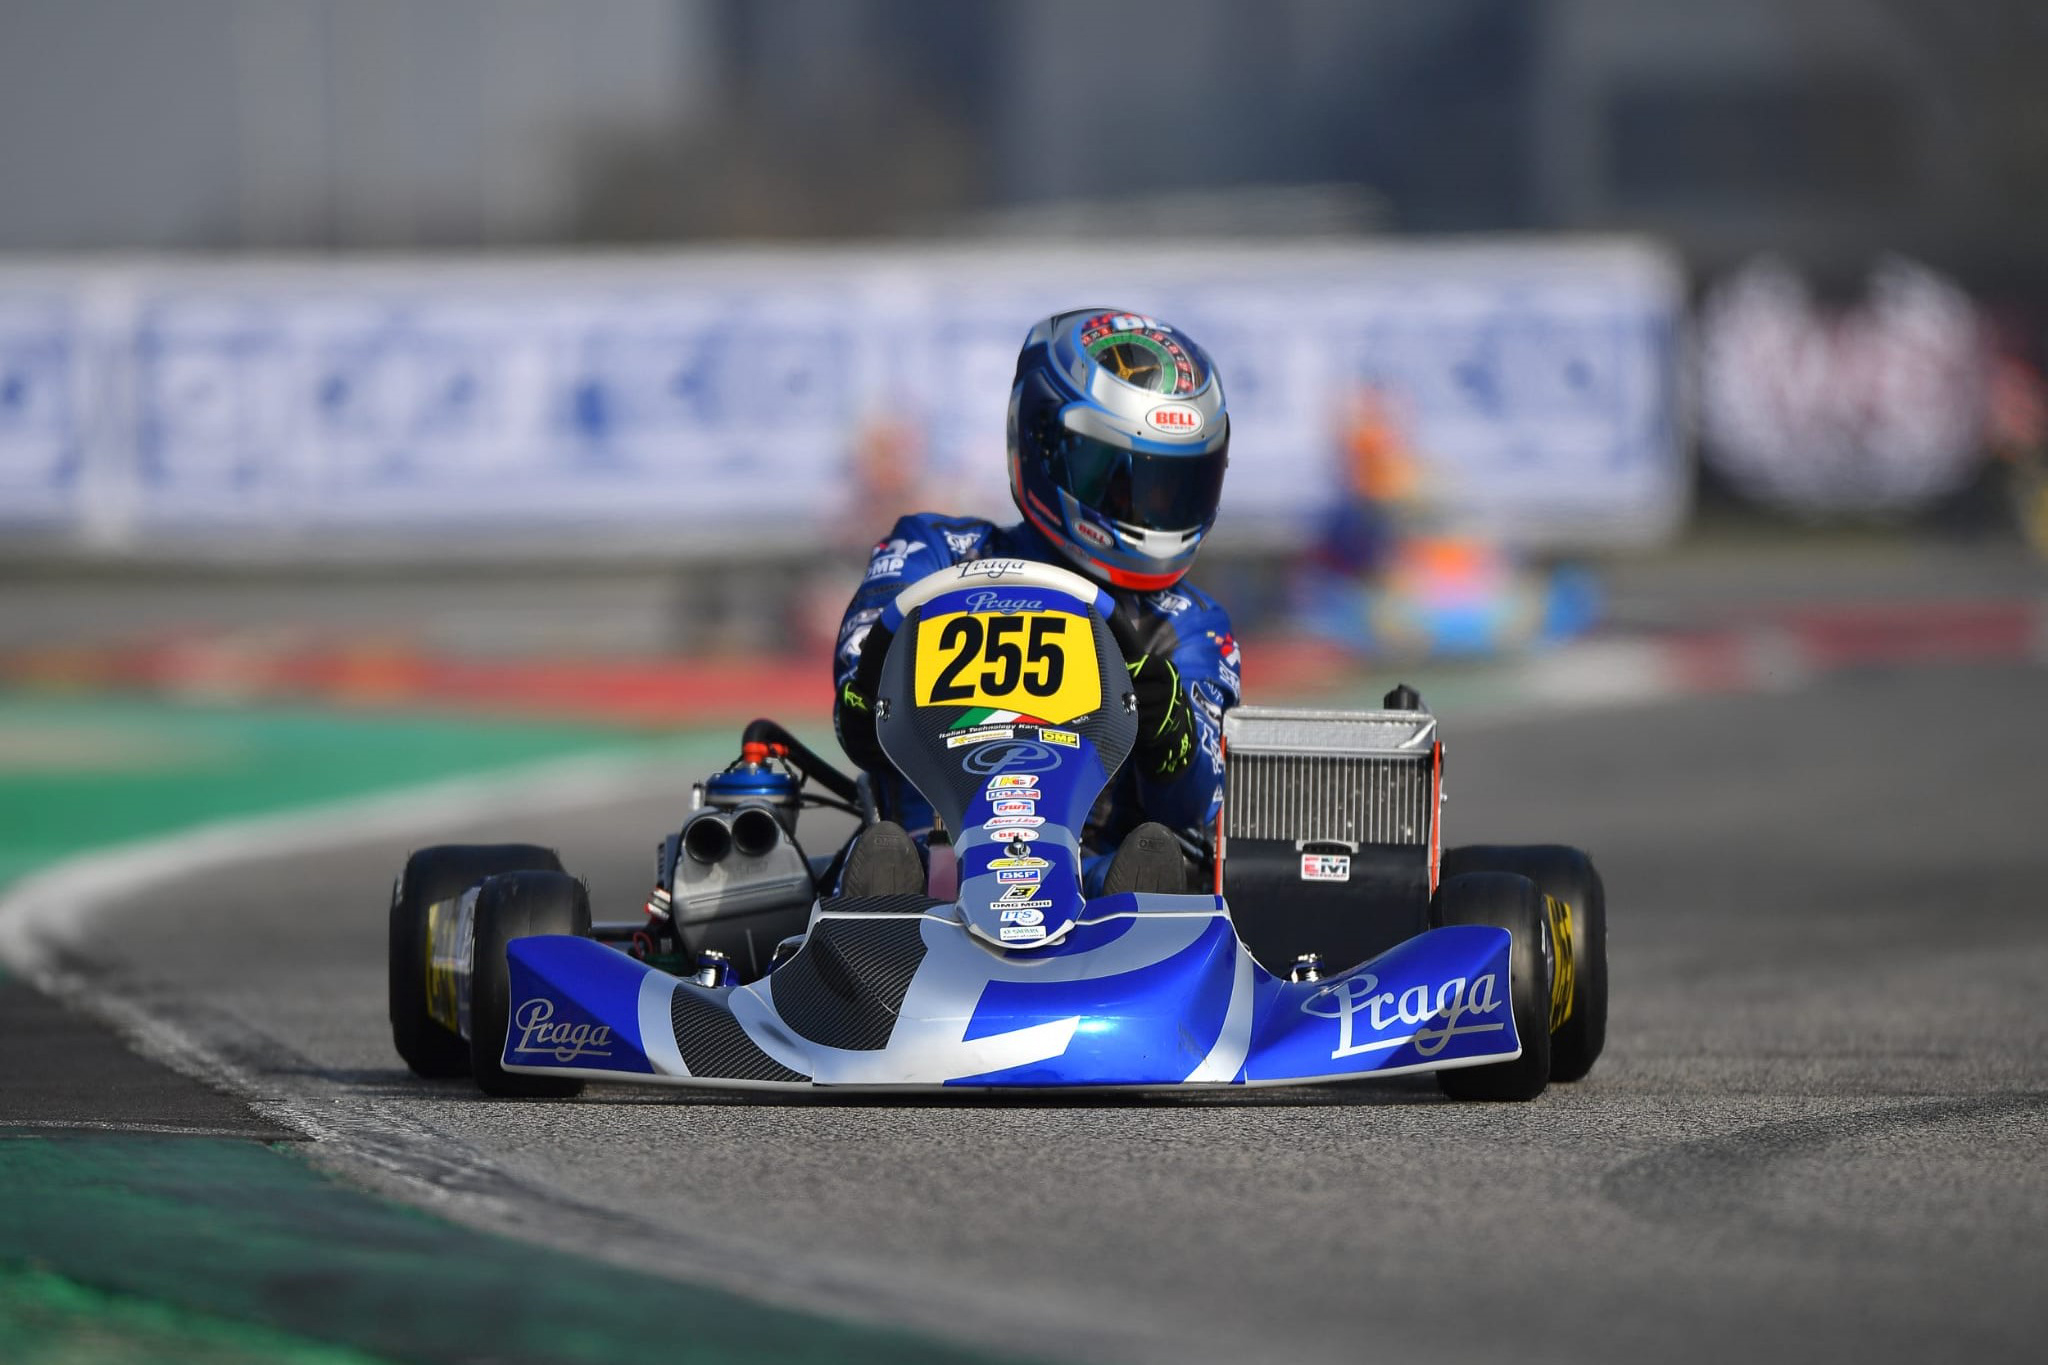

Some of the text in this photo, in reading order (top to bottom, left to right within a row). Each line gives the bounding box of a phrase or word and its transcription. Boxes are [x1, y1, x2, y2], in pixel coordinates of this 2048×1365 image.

[1155, 411, 1195, 426] BELL
[1078, 523, 1106, 544] BELL
[965, 591, 1044, 615] Praga
[929, 615, 1067, 704] 255
[938, 729, 967, 739] Italian
[969, 723, 1017, 734] Technology
[1043, 731, 1077, 746] OMP
[1001, 870, 1036, 879] SKF
[1005, 910, 1033, 919] ITS
[1301, 973, 1505, 1059] Praga
[514, 998, 612, 1062] Praga
